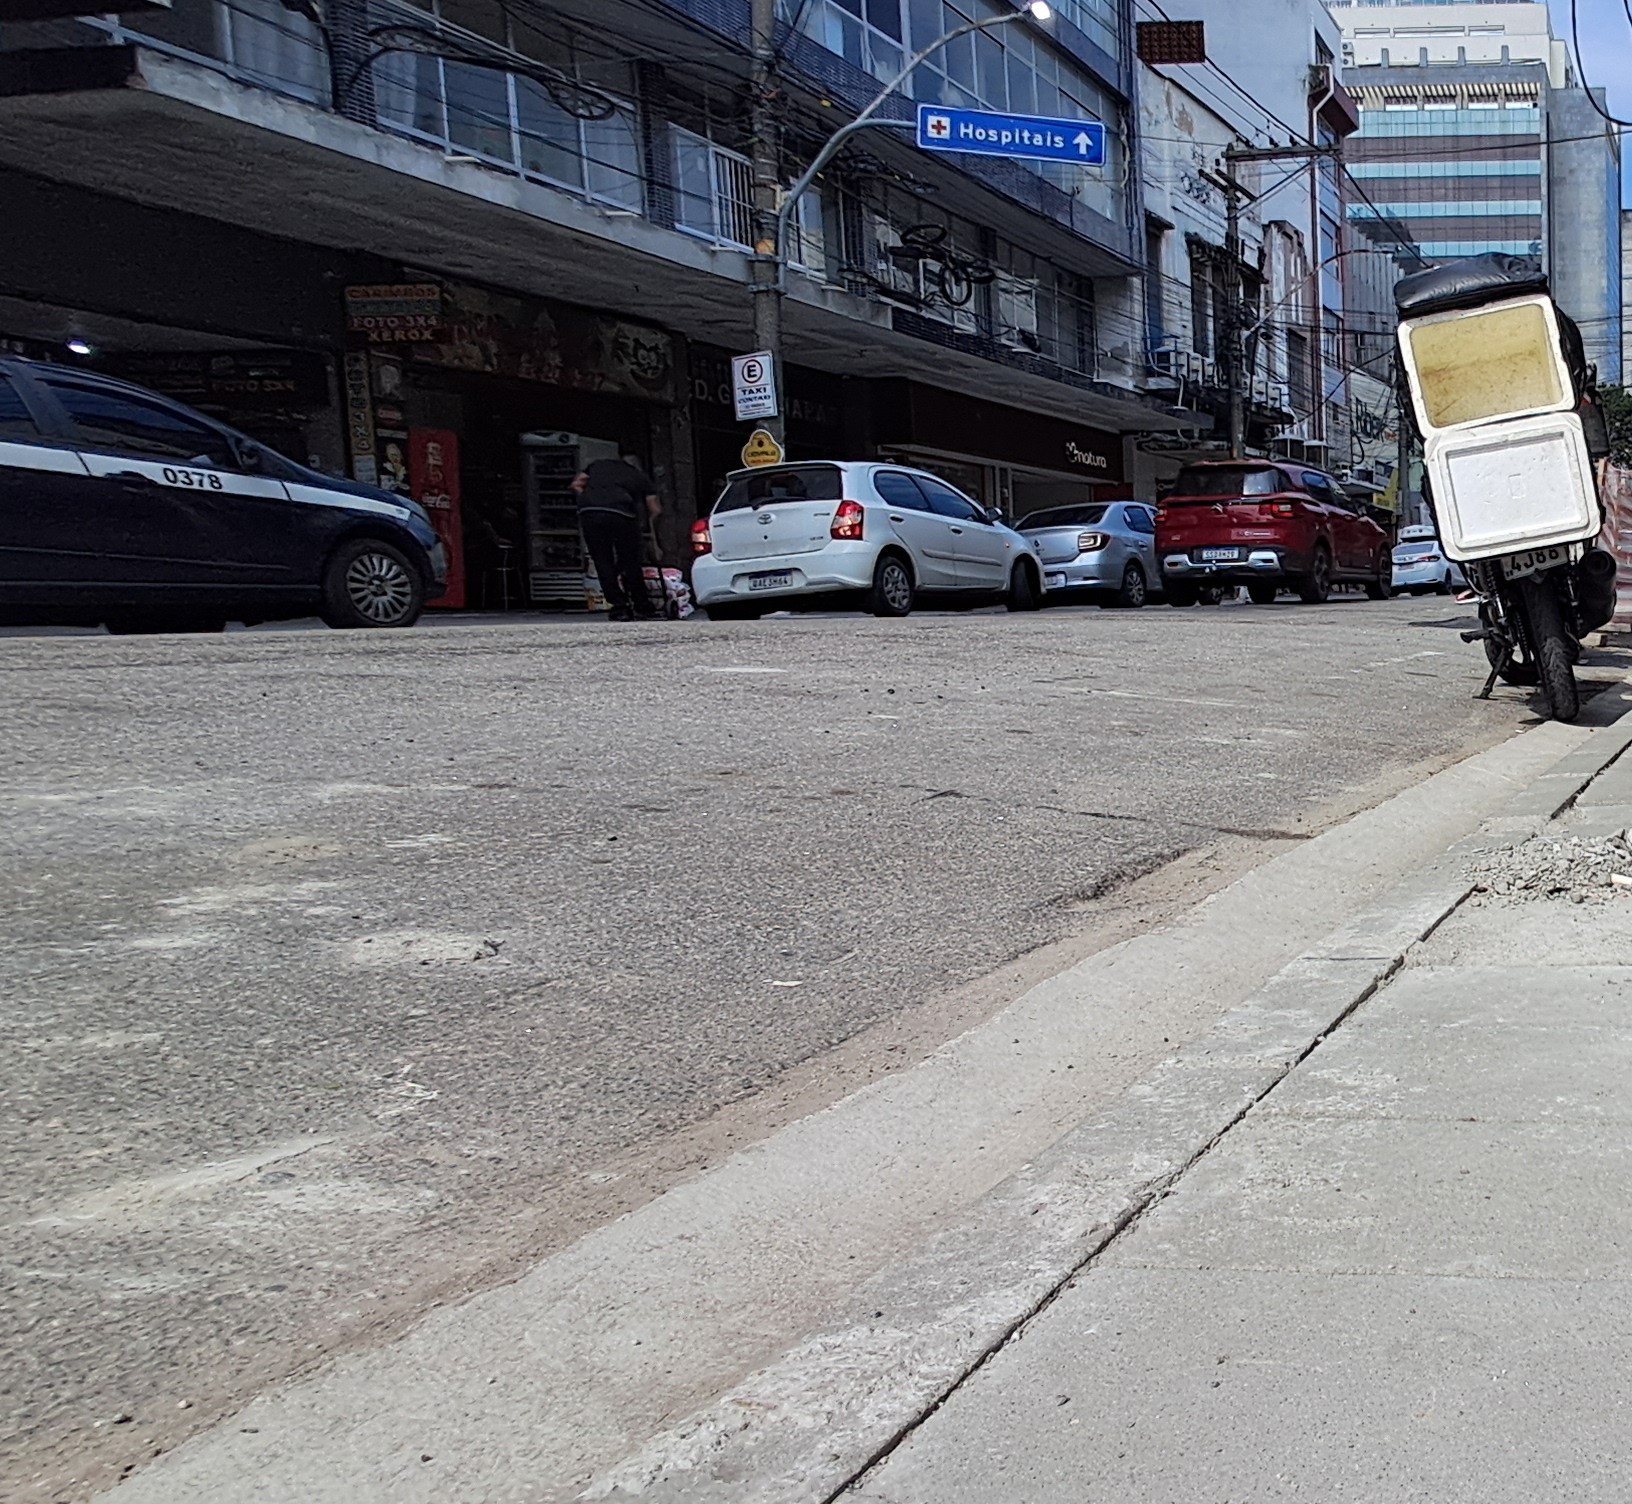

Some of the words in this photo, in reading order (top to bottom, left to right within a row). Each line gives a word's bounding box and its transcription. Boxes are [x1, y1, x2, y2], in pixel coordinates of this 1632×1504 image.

[959, 121, 1065, 149] Hospitais
[353, 316, 400, 328] FOTO
[368, 329, 433, 342] XEROX
[747, 364, 757, 378] E
[741, 387, 767, 396] TAXI
[1077, 450, 1107, 469] natura
[163, 467, 223, 491] 0378
